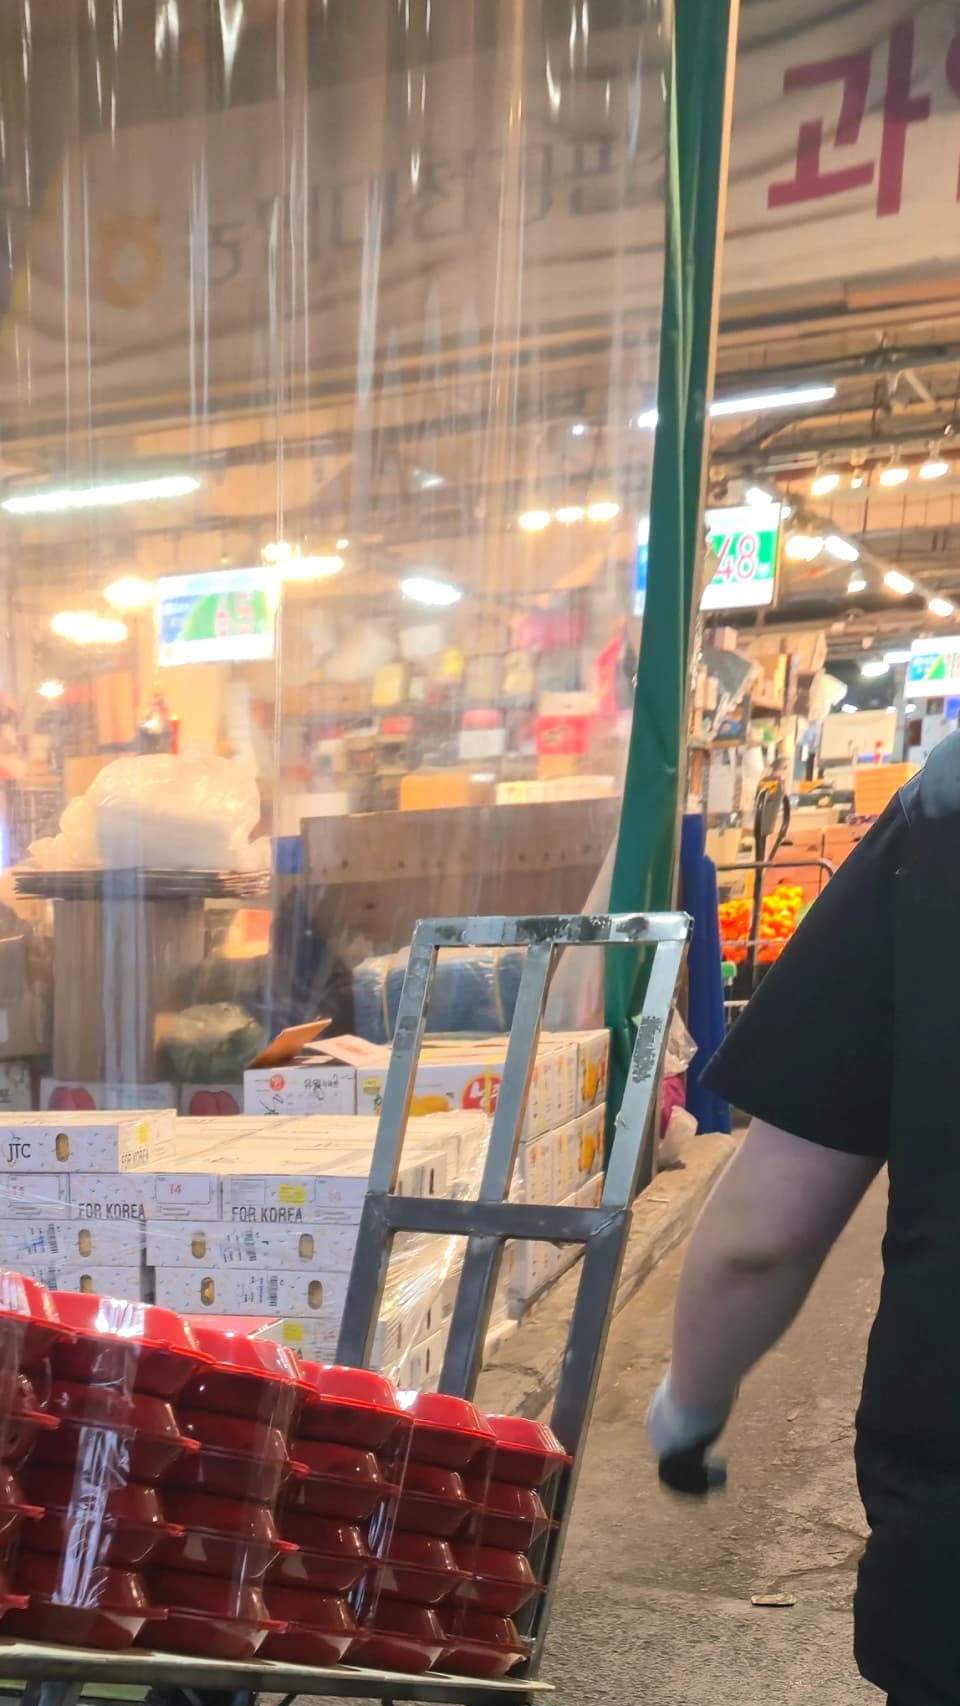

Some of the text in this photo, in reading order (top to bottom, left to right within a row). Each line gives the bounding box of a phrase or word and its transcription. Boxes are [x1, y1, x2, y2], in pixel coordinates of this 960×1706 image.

[767, 15, 960, 219] 과
[714, 532, 757, 582] 48
[7, 1143, 31, 1162] JTC
[79, 1203, 145, 1220] FOR KOREA
[231, 1206, 303, 1224] FOR KOREA
